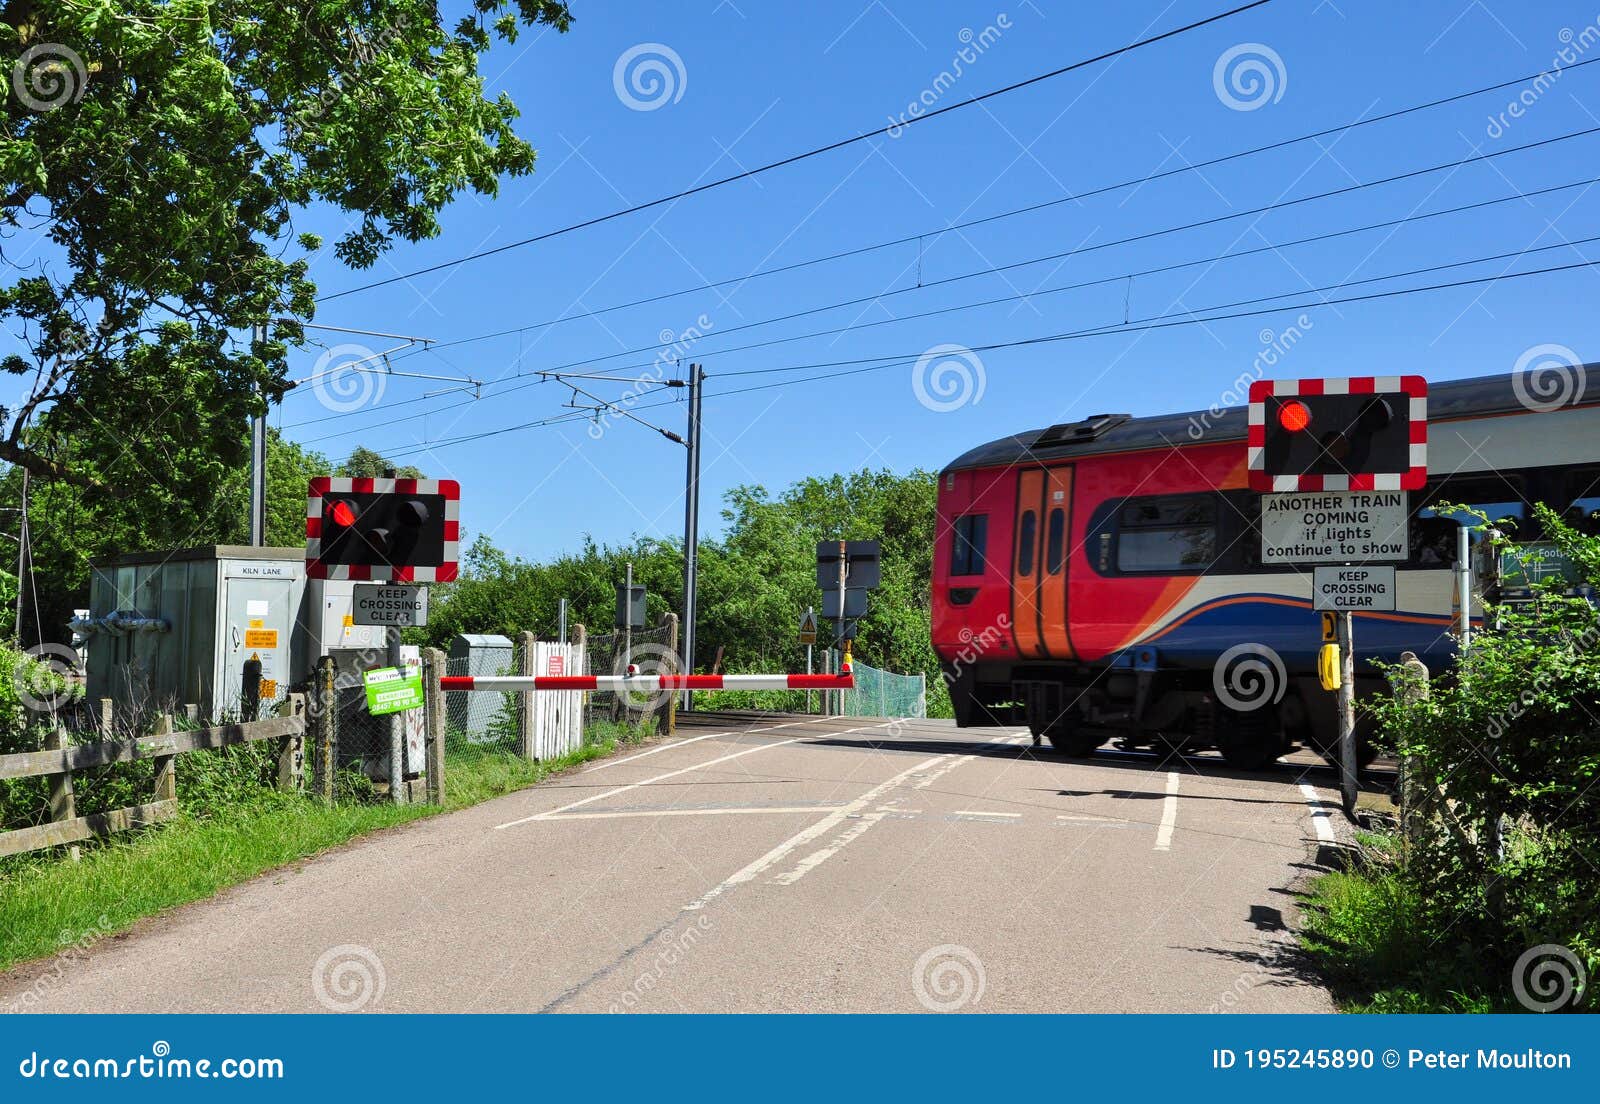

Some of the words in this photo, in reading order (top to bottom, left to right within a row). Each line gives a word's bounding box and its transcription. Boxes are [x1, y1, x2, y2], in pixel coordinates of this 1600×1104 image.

[1268, 497, 1343, 511] ANOTHER
[1350, 494, 1401, 508] TRAIN
[1303, 511, 1369, 525] COMING
[1306, 528, 1317, 541] if
[1326, 527, 1371, 542] lights
[1267, 544, 1332, 557] continue
[1340, 546, 1355, 555] to
[1362, 542, 1402, 554] show
[242, 567, 259, 575] KILN
[1338, 571, 1369, 582] KEEP
[377, 589, 408, 599] KEEP
[1322, 584, 1386, 594] CROSSING
[360, 600, 422, 611] CROSSING
[1334, 596, 1373, 606] CLEAR
[370, 611, 410, 621] CLEAR
